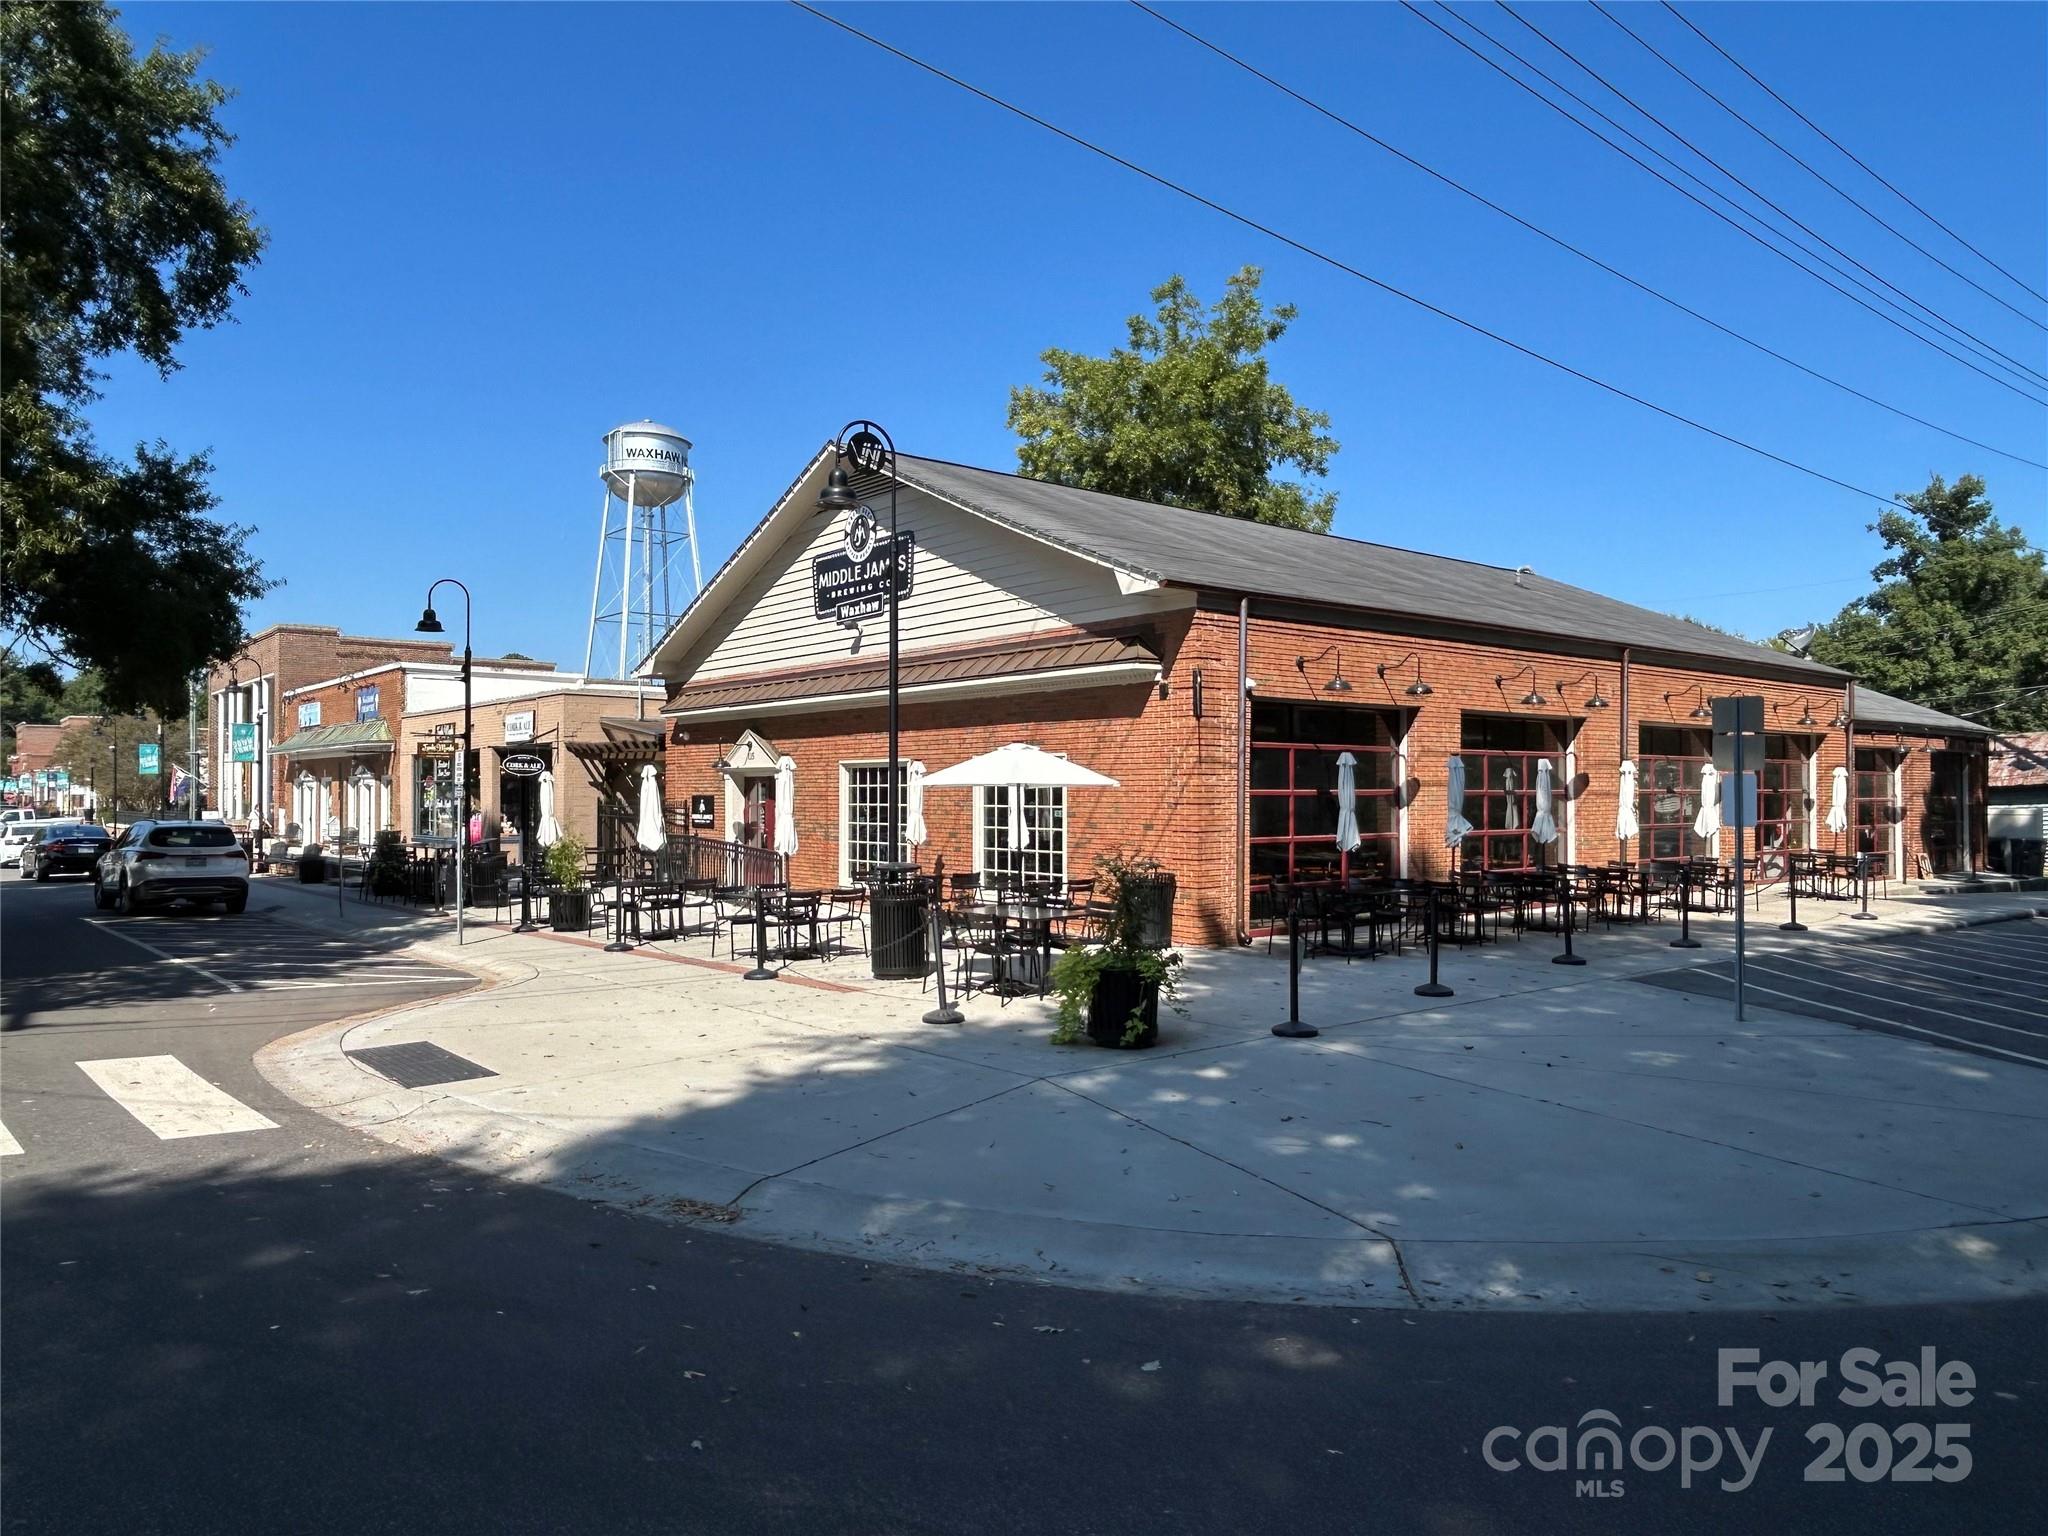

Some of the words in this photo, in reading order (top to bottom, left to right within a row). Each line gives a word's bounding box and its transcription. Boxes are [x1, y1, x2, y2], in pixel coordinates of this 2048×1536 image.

[626, 448, 681, 464] WAXHAW
[819, 564, 862, 589] MIDDLE
[863, 554, 907, 579] JAMS
[831, 583, 873, 598] BREWING
[840, 600, 880, 618] Waxhaw
